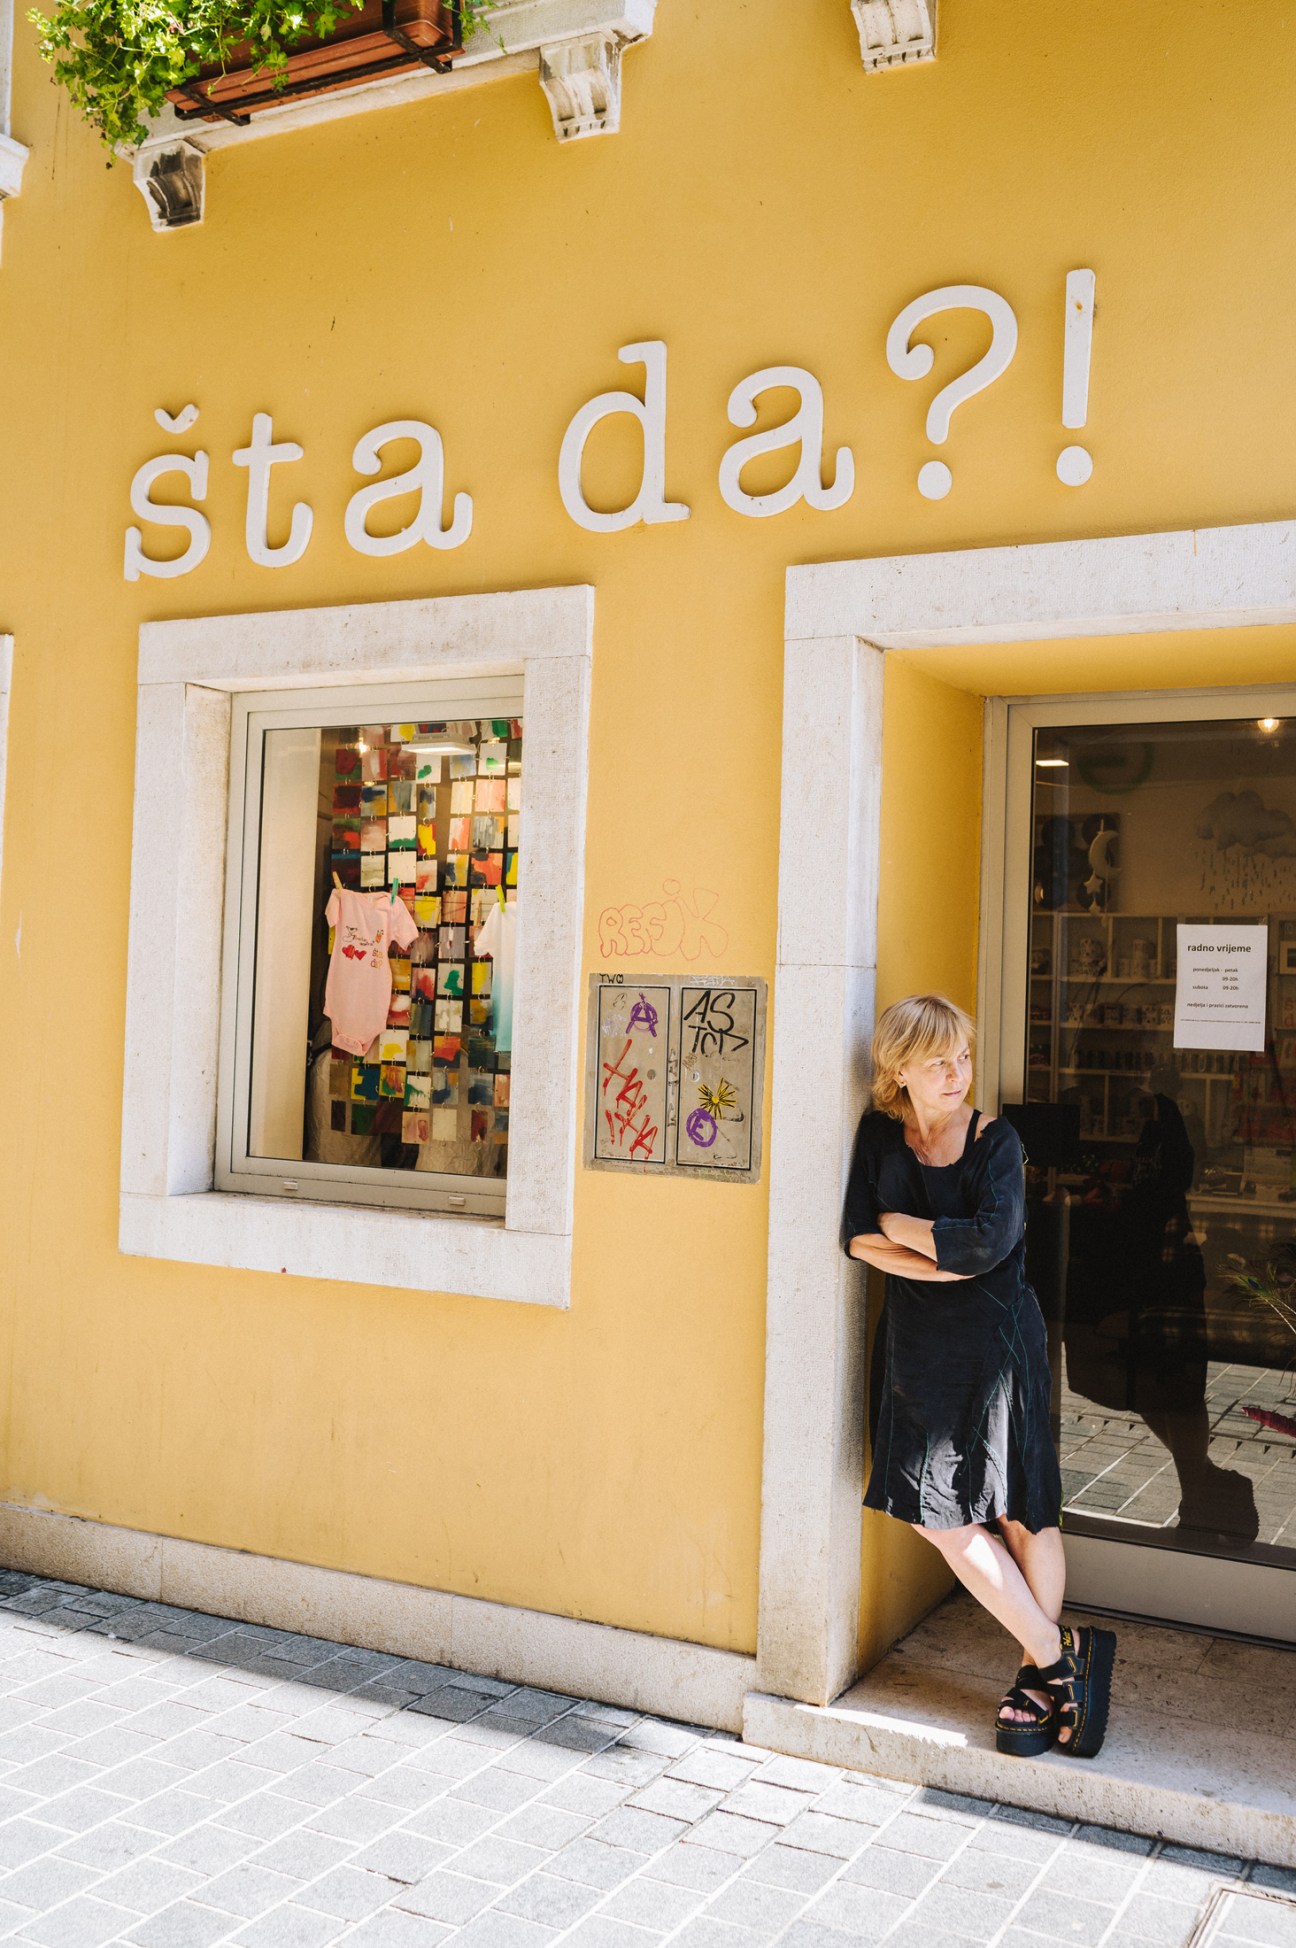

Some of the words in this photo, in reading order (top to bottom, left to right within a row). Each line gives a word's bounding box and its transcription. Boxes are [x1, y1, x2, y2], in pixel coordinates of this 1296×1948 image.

[124, 403, 473, 581] šta
[557, 268, 1096, 533] da?!
[1188, 944, 1214, 952] radno
[1216, 944, 1252, 954] vrijeme
